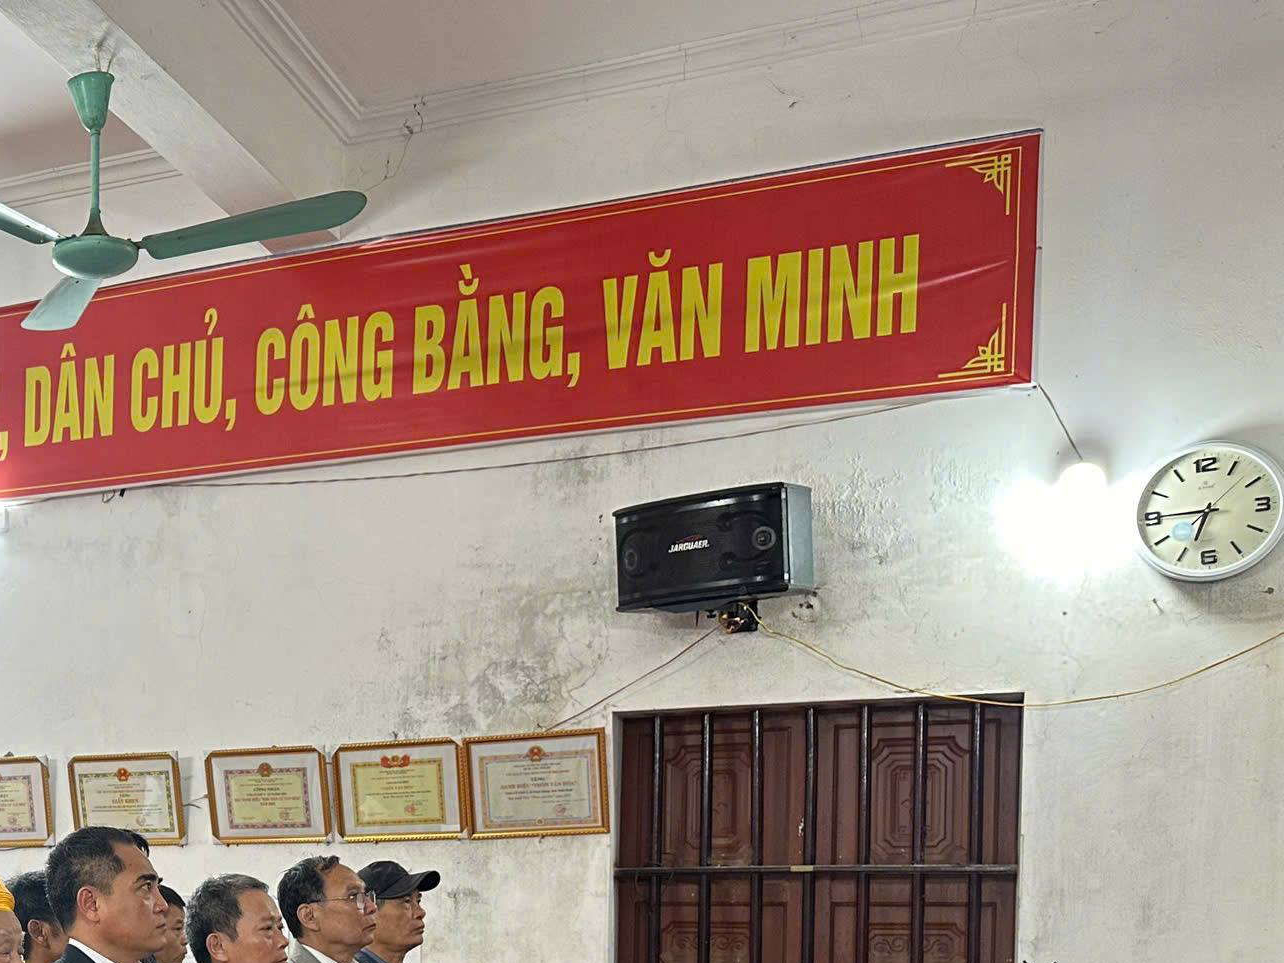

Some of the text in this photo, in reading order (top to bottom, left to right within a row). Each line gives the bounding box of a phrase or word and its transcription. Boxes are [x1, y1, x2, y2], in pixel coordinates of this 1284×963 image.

[24, 343, 115, 446] DÂN
[131, 308, 237, 431] CHỦ,
[255, 304, 394, 416] CÔNG
[412, 264, 581, 394] BẰNG,
[603, 250, 723, 370] VĂN
[745, 234, 920, 353] MINH
[1193, 457, 1220, 473] 12
[1254, 496, 1271, 512] 3
[1144, 511, 1162, 527] 9
[1200, 549, 1218, 565] 6
